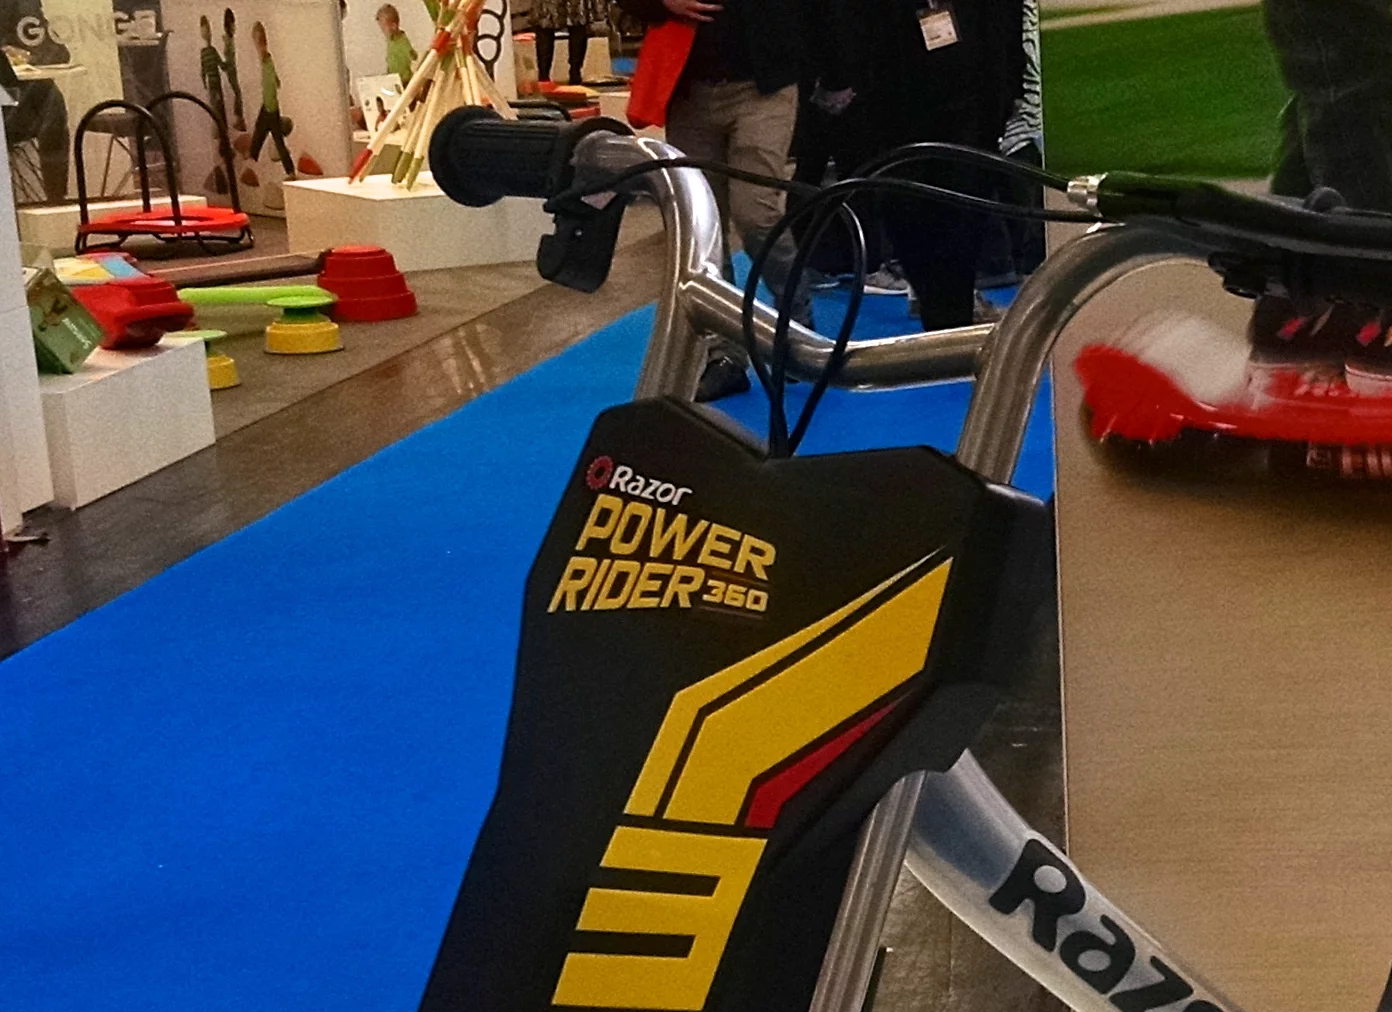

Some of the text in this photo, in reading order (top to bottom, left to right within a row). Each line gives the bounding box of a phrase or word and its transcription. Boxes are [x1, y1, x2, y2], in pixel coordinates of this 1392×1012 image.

[609, 465, 693, 505] Razor
[575, 493, 776, 581] POWER
[548, 556, 768, 613] RIDER 360
